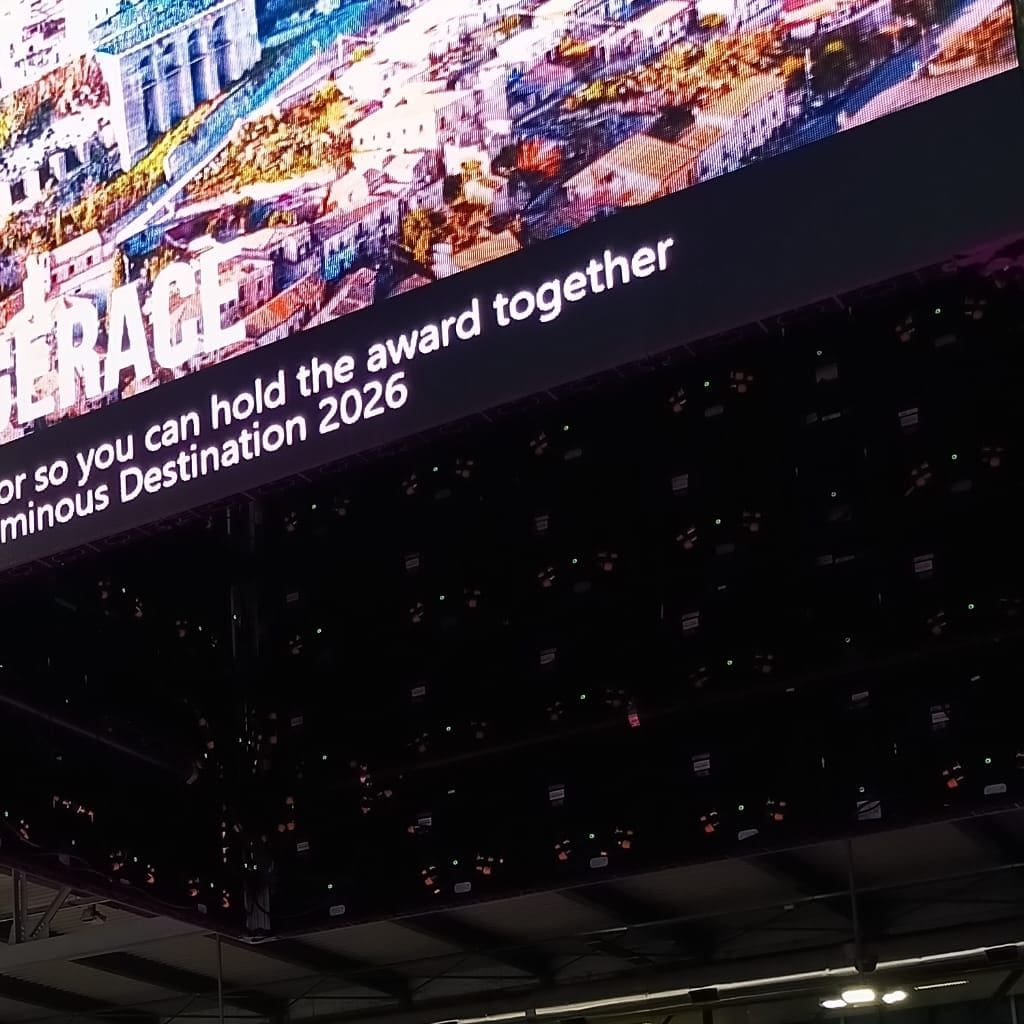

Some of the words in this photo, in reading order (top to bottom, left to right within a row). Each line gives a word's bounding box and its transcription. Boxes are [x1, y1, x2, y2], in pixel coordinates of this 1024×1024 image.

[34, 460, 69, 492] so
[75, 434, 134, 487] you
[144, 411, 200, 452] can
[211, 369, 286, 430] hold
[295, 355, 355, 397] the
[366, 297, 481, 373] award
[492, 237, 674, 327] together
[119, 415, 307, 503] Destination
[318, 371, 408, 434] 2026
